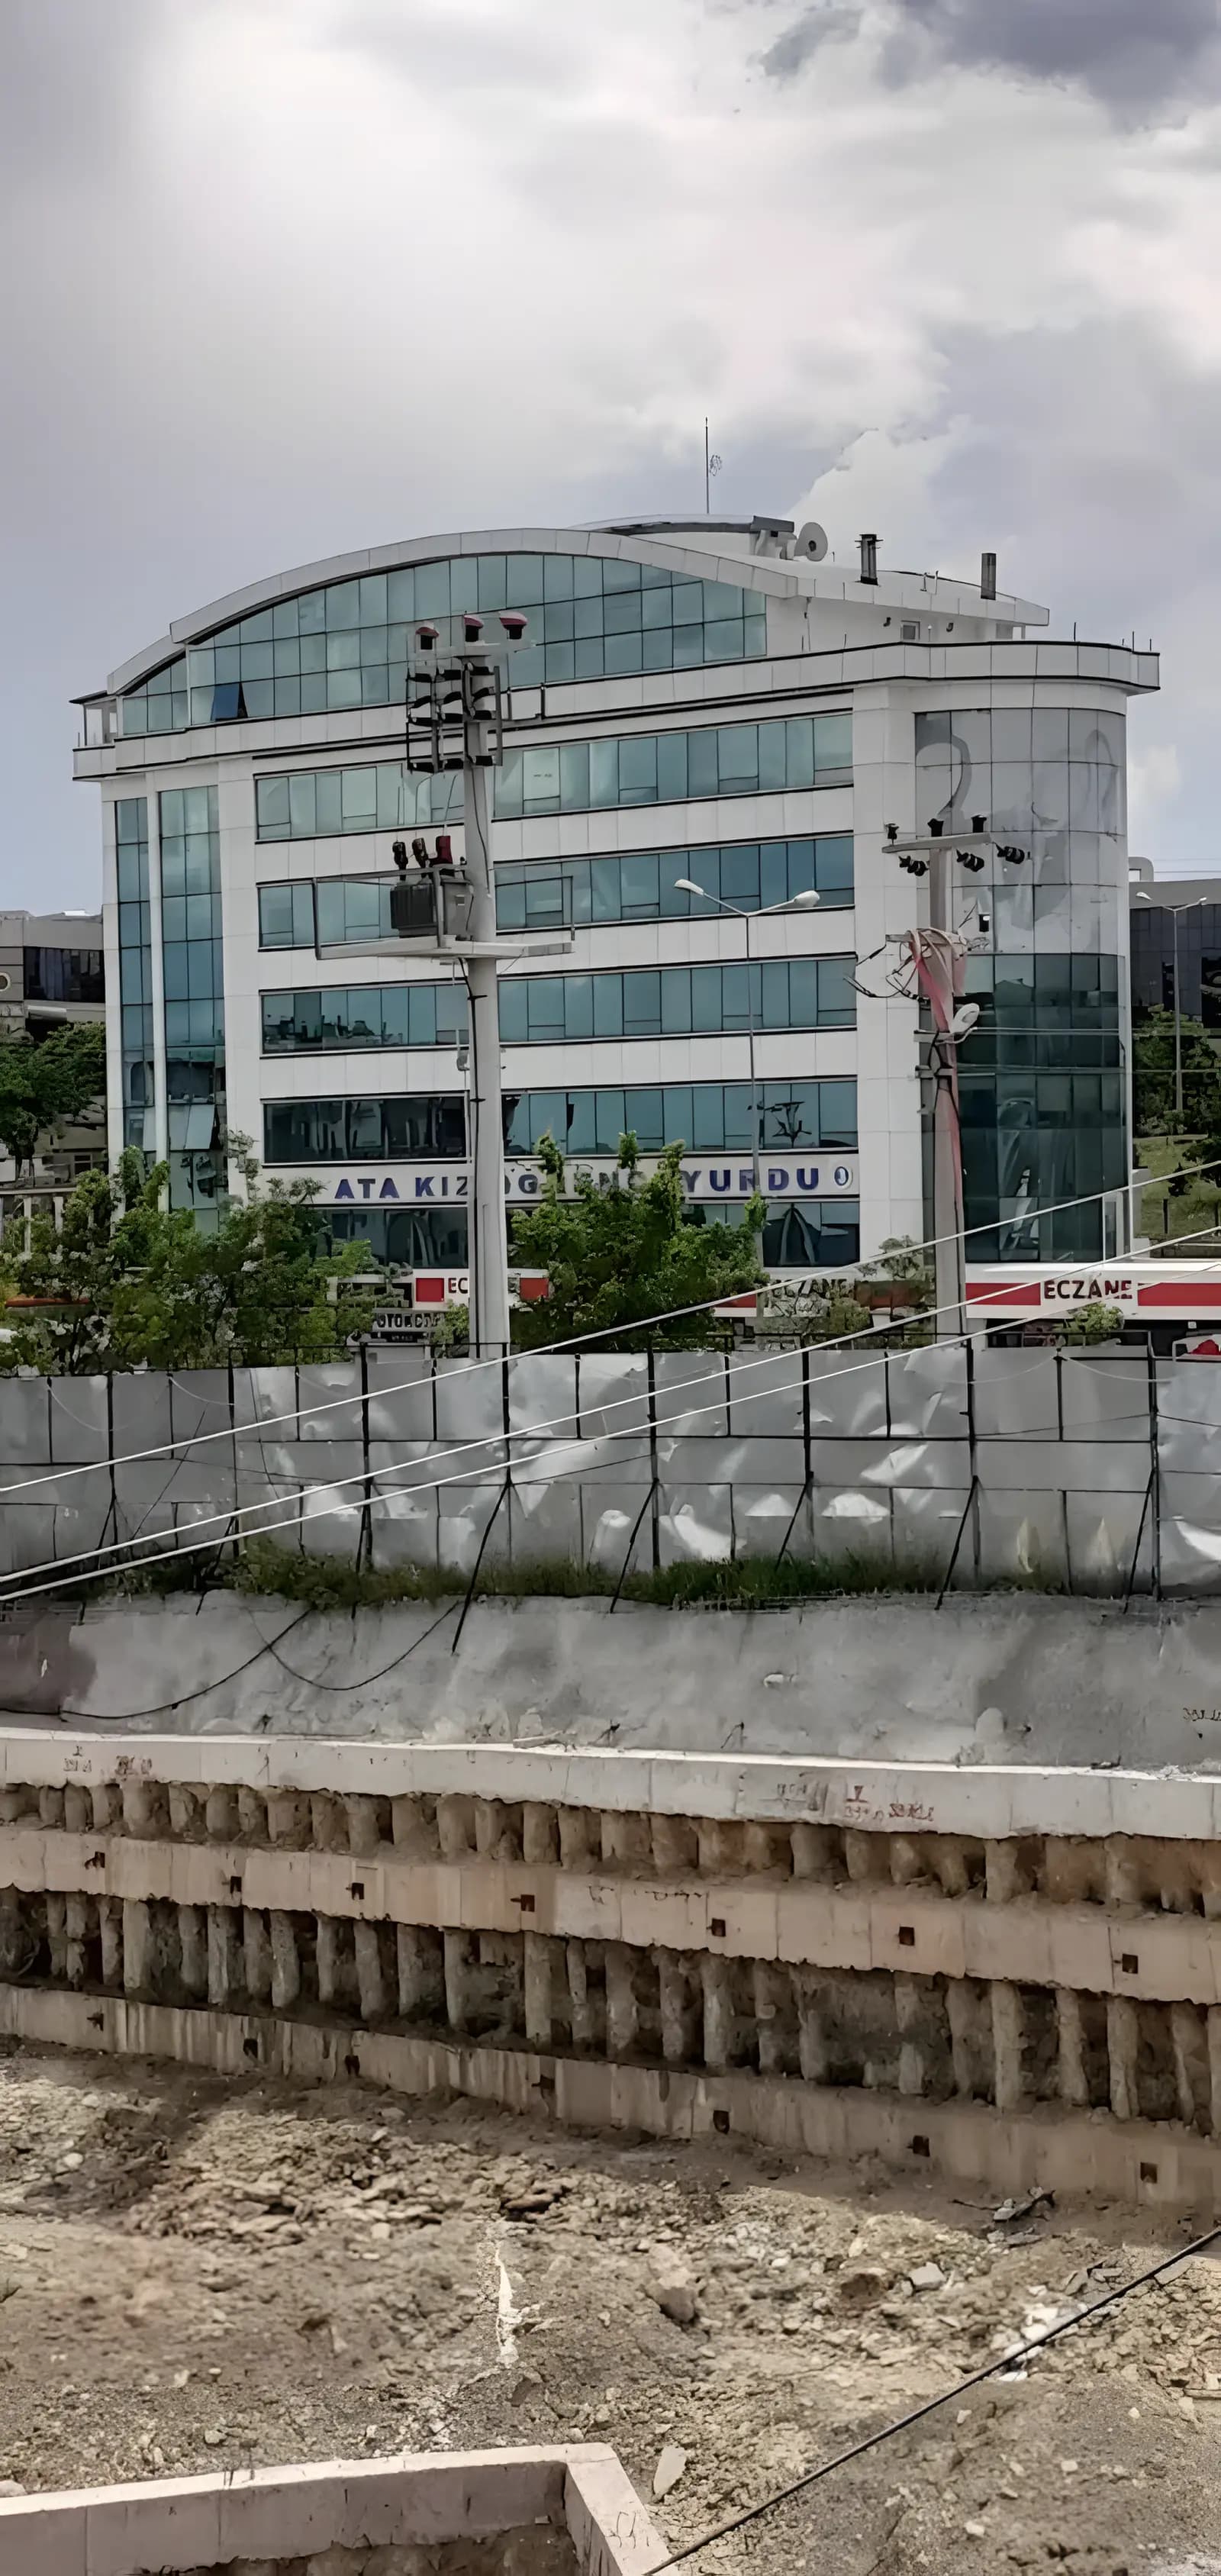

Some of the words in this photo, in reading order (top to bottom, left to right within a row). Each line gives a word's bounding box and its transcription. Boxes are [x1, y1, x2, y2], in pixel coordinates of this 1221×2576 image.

[334, 1177, 400, 1199] ATA
[681, 1168, 819, 1192] YURDU
[1043, 1279, 1132, 1299] ECZANE
